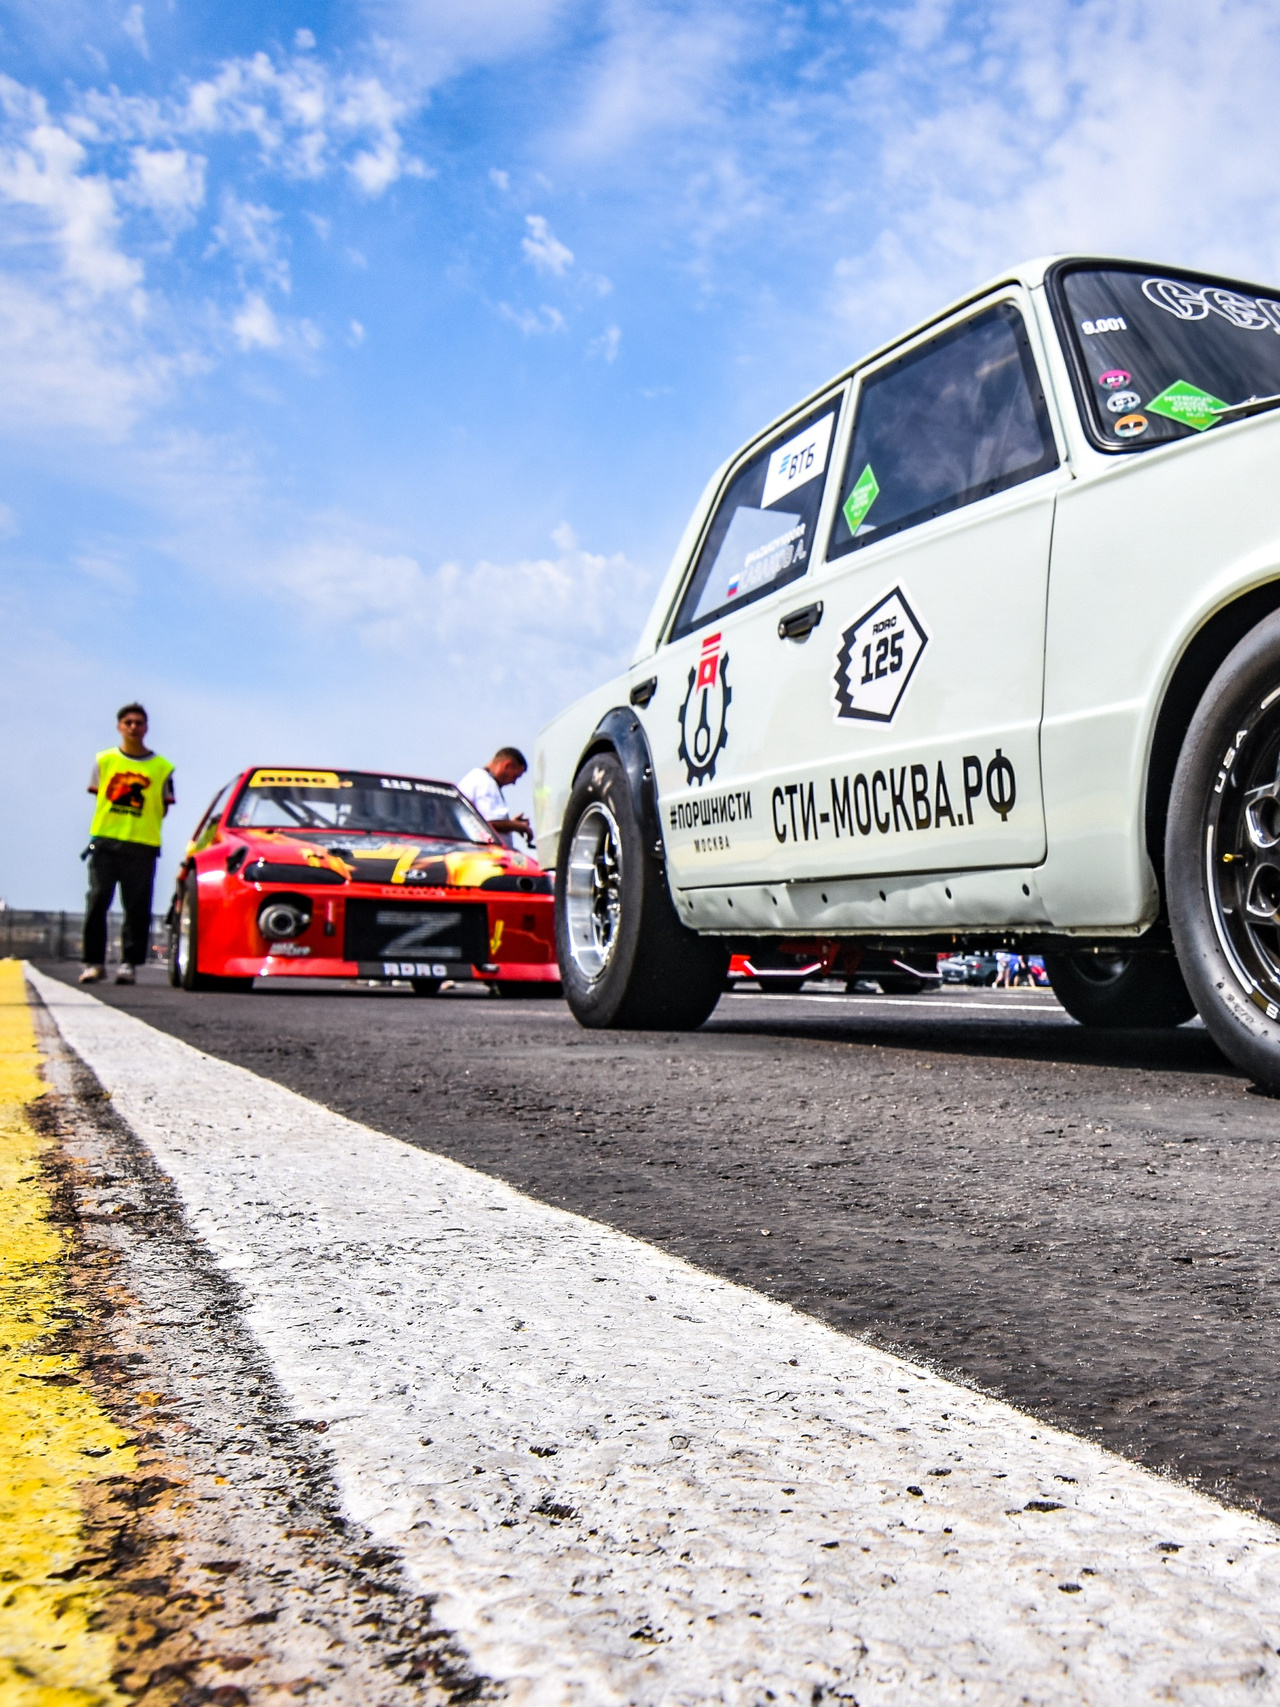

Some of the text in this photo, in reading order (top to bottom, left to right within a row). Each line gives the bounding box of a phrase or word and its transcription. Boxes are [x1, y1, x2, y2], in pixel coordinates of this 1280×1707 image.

[788, 442, 816, 480] ВТБ
[861, 629, 904, 685] 125
[1214, 730, 1247, 793] USA
[670, 791, 752, 830] #ПОРШНИСТИ
[772, 748, 1016, 845] СТИ-МОСКВА.РФ
[694, 835, 730, 853] МОСКВА
